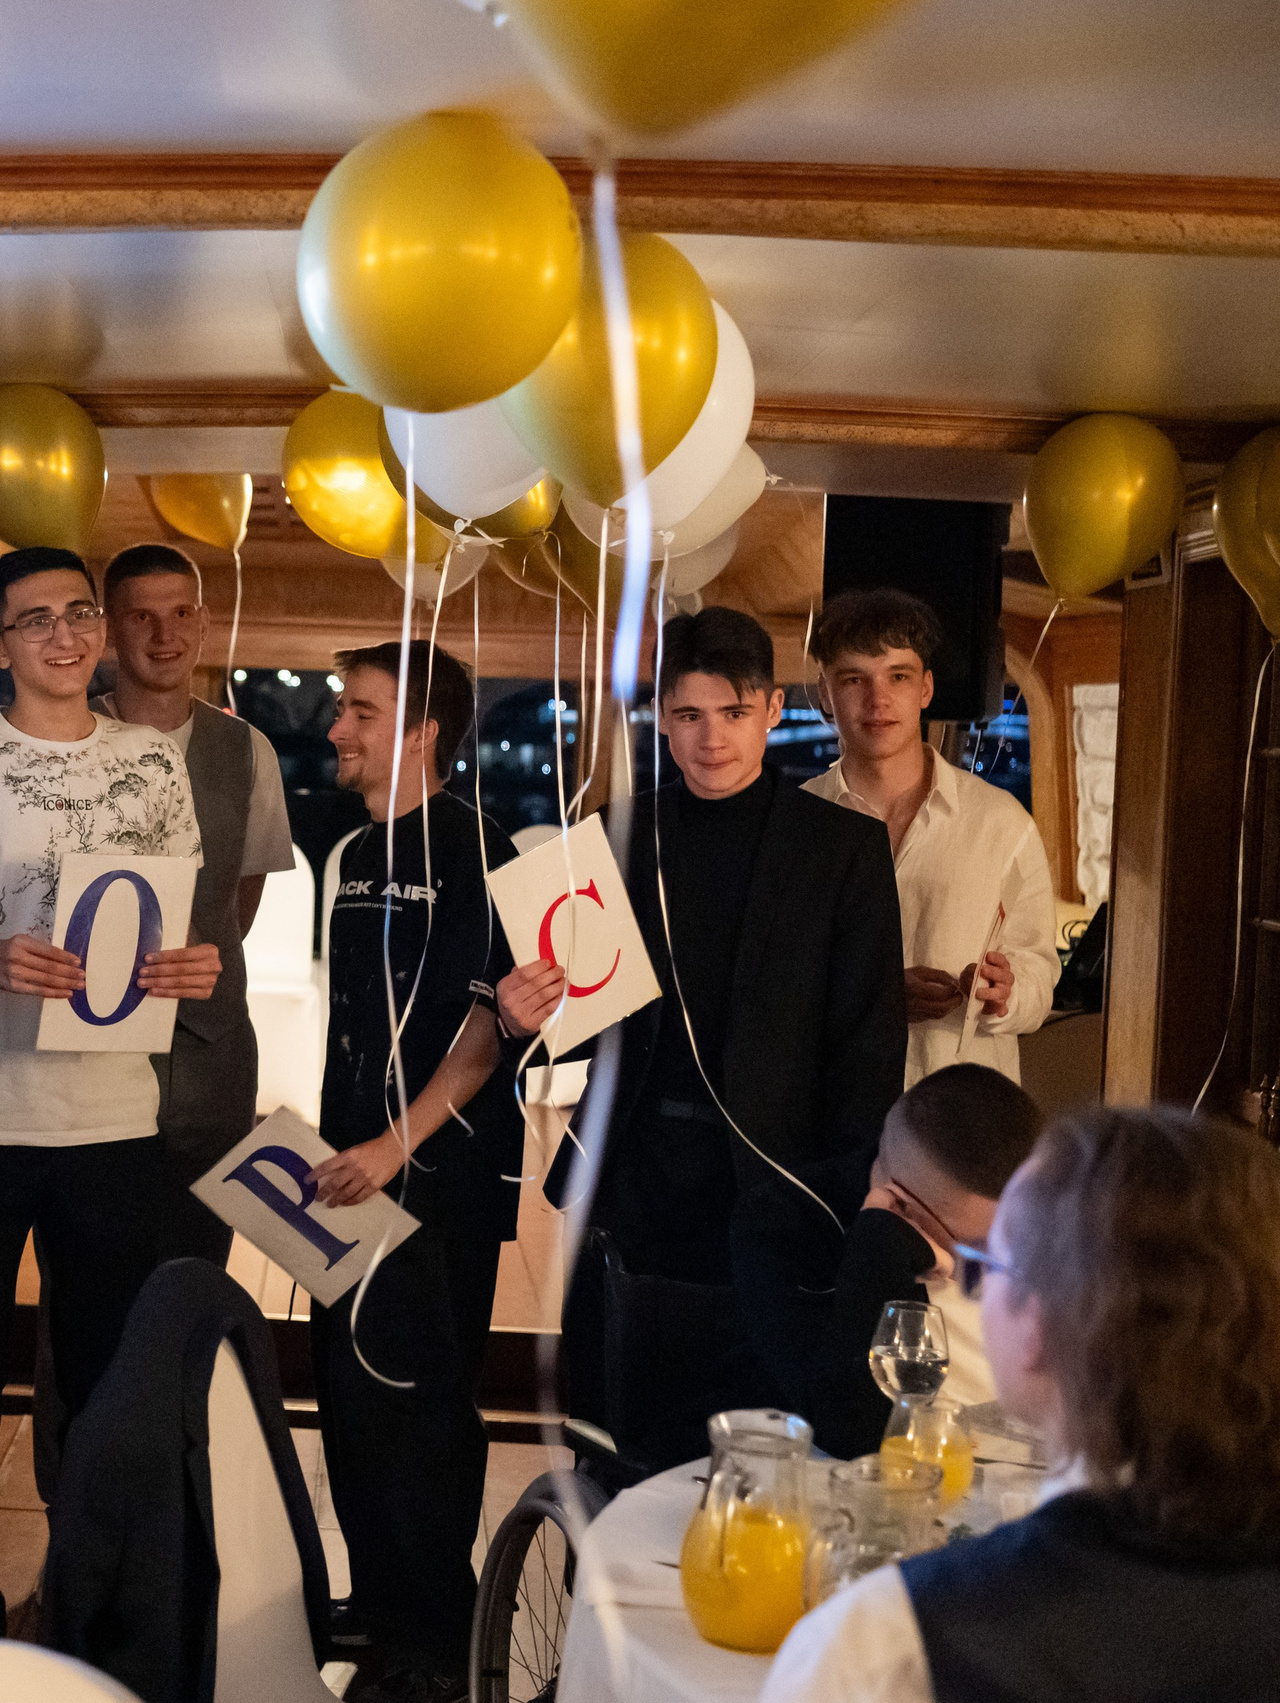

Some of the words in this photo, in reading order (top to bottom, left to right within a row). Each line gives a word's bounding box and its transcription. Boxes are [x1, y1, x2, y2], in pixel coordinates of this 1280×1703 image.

[380, 881, 437, 904] AIR
[538, 878, 621, 998] C
[222, 1145, 360, 1272] P
